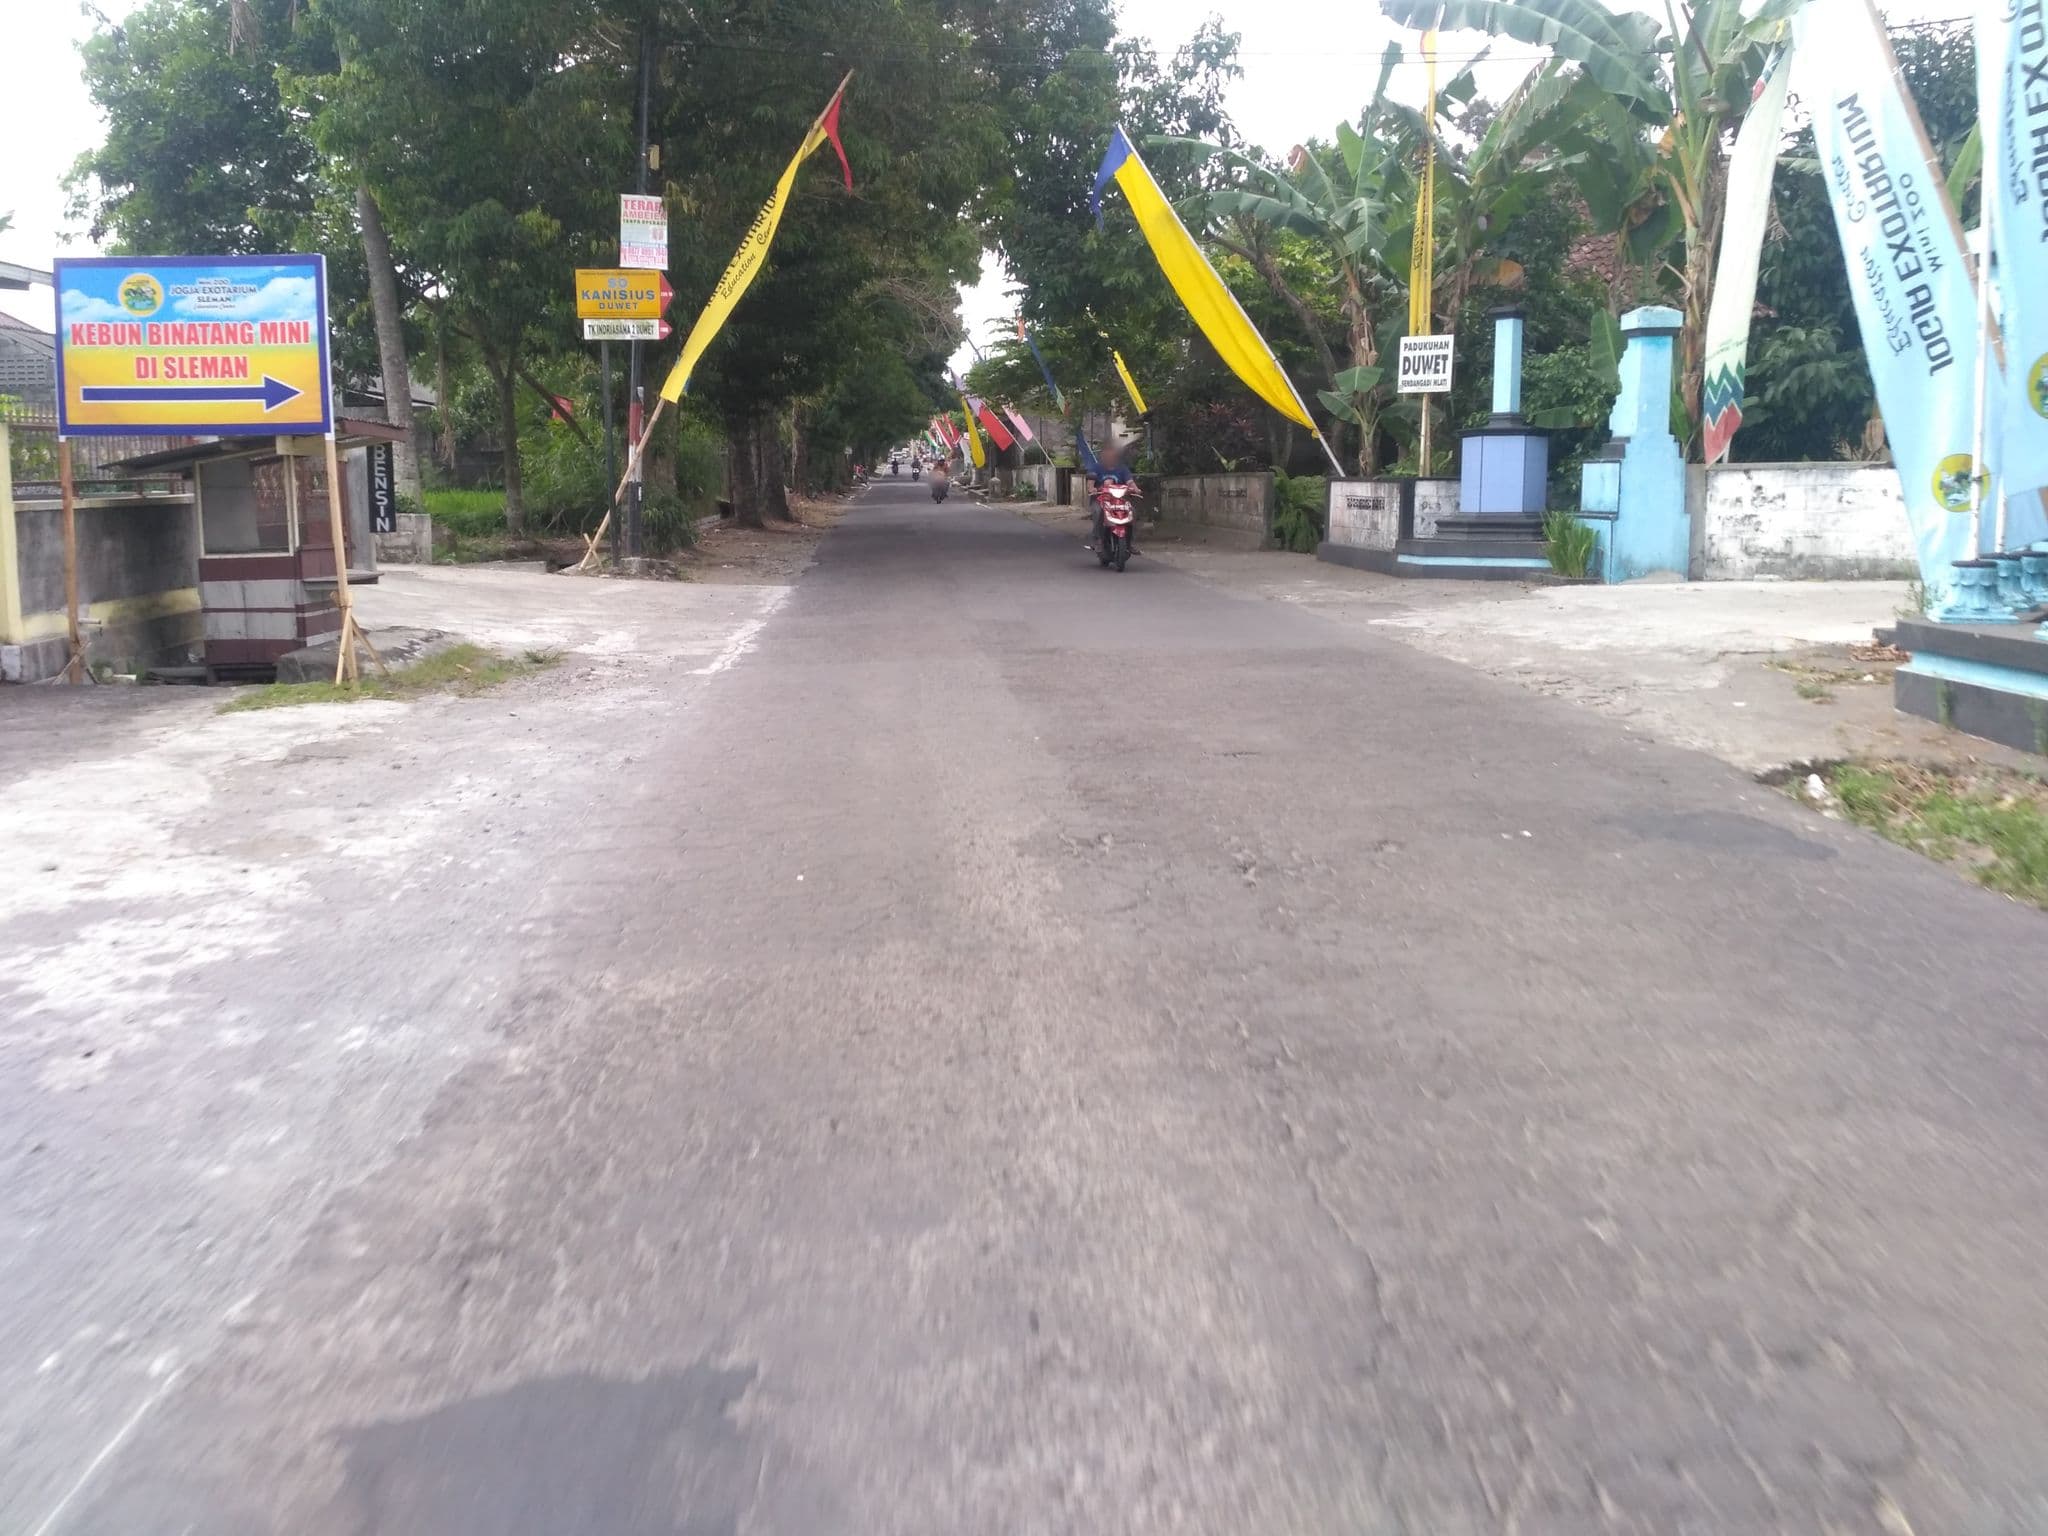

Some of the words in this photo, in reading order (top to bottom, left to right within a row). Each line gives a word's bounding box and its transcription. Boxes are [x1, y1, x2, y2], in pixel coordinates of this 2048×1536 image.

[623, 211, 667, 220] AMBEIEN
[720, 252, 757, 301] Education
[171, 286, 199, 295] JOGJA
[202, 286, 257, 294] EXOTARIUM
[582, 289, 656, 301] KANISIUS
[599, 302, 639, 310] DUWET
[71, 321, 142, 346] KEBUN
[147, 321, 254, 345] BINATANG
[260, 320, 310, 344] MINI
[1403, 340, 1450, 352] PADUKUHAN
[135, 356, 157, 379] DI
[164, 355, 249, 379] SLEMAN
[1402, 354, 1449, 376] DUWET
[374, 444, 390, 532] BENSIN
